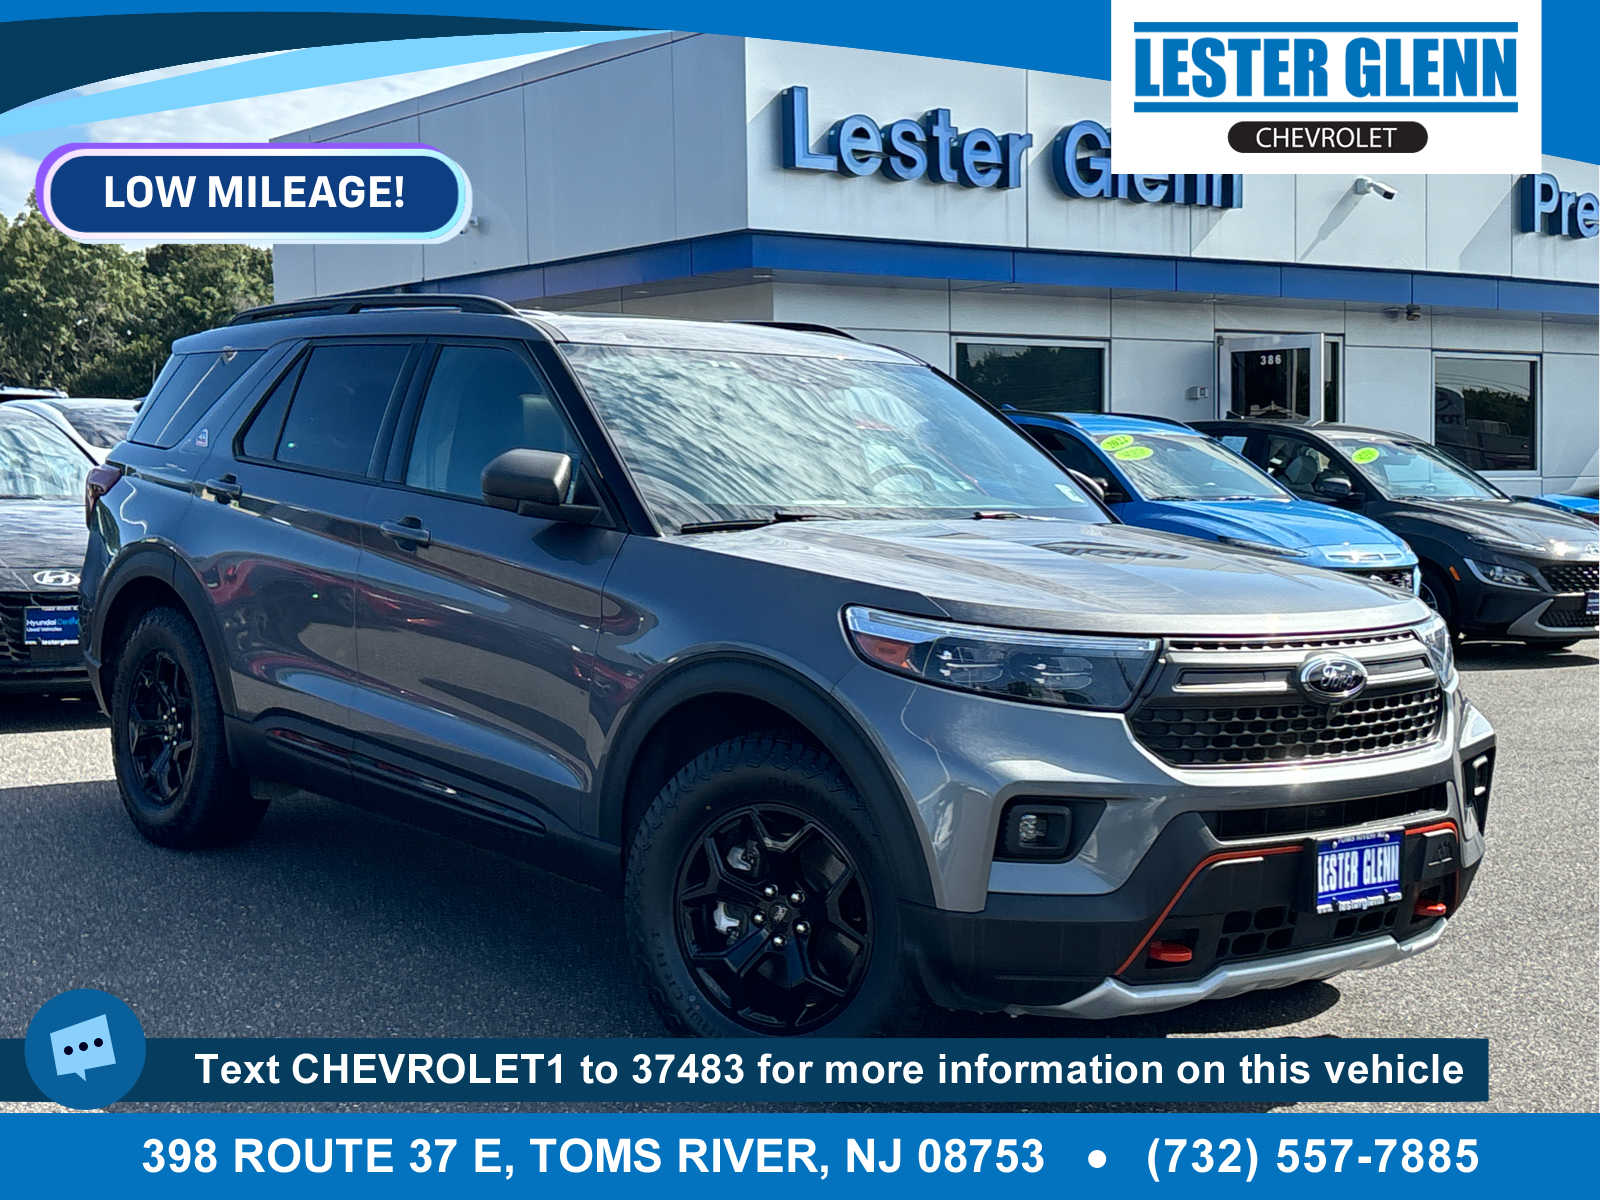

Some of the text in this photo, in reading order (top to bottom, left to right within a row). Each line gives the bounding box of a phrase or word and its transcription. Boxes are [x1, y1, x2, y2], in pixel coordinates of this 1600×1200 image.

[782, 85, 1033, 191] Lester
[1521, 173, 1599, 238] Pre
[1260, 354, 1282, 366] 386
[26, 618, 57, 627] Hyundai
[1320, 664, 1361, 688] Ford
[1317, 845, 1400, 893] LESTER GLENN
